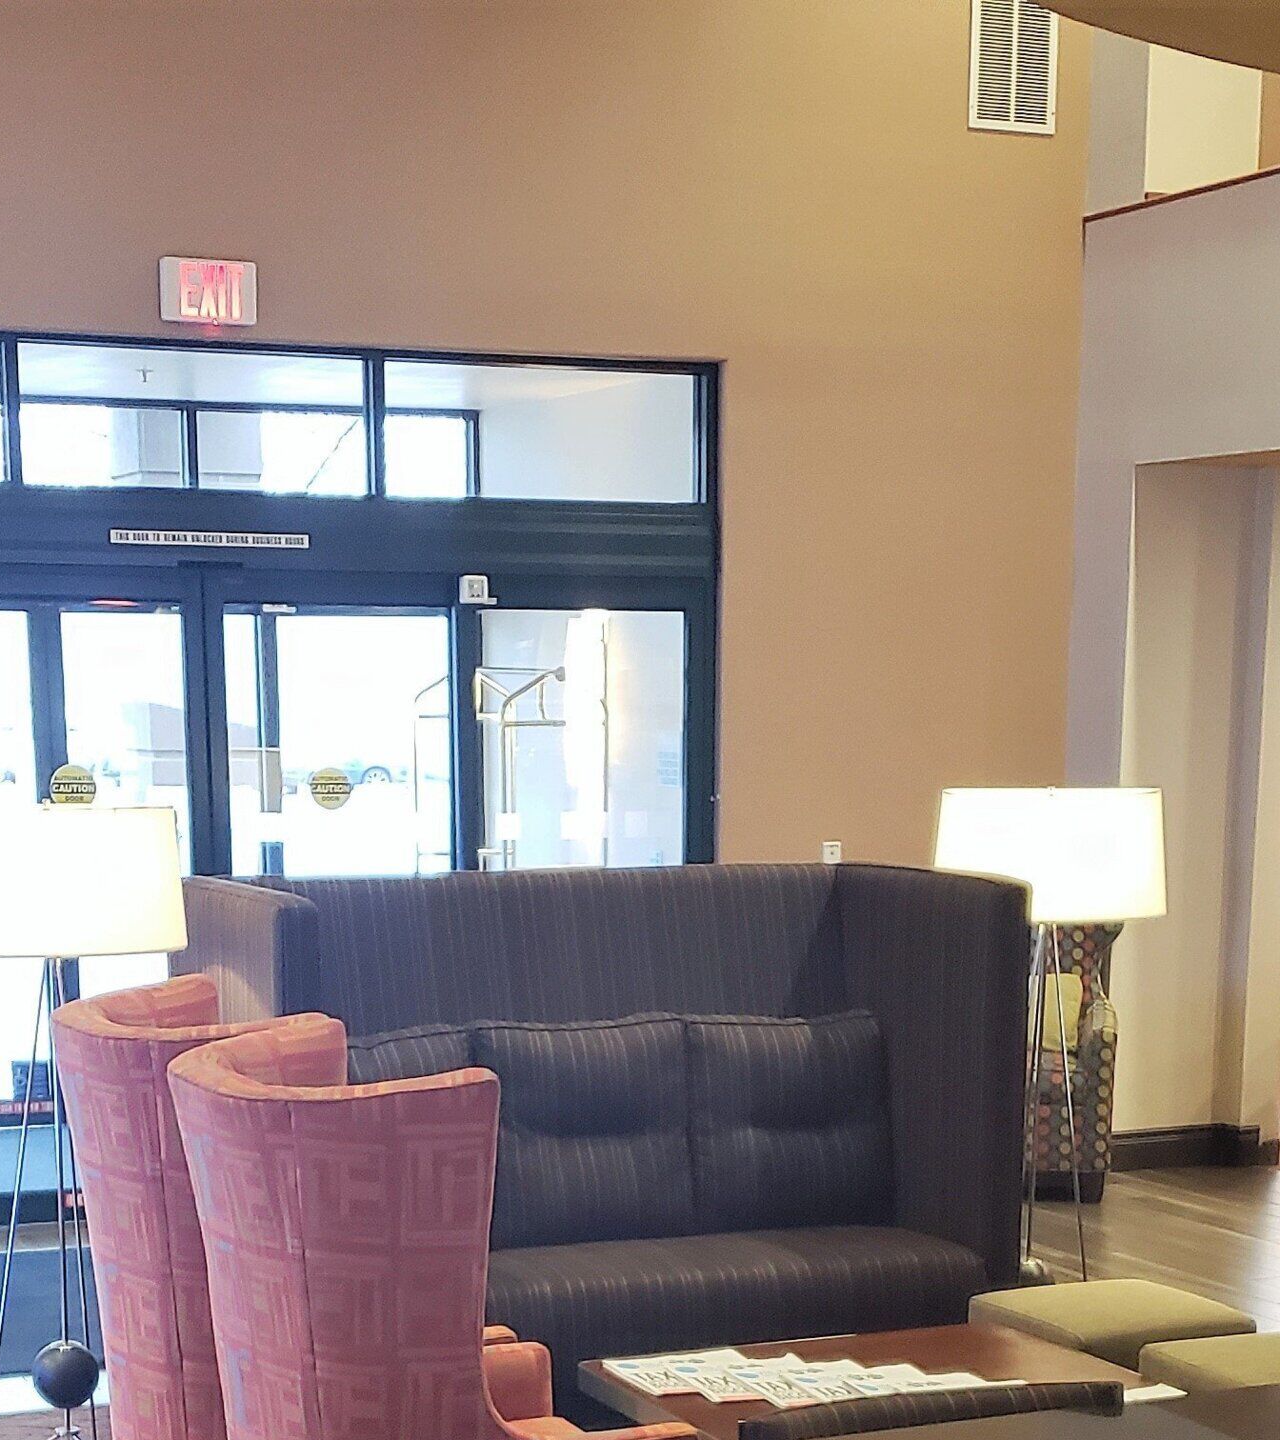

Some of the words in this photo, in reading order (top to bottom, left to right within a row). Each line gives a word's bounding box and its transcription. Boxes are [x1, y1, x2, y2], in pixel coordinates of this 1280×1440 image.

[179, 262, 244, 320] EXIT
[133, 533, 149, 541] DOOR
[153, 533, 160, 541] TO
[192, 534, 223, 543] UNLOCKED
[226, 535, 249, 544] DURING
[252, 536, 281, 544] BUSINESS
[52, 783, 95, 793] CAUTION
[311, 784, 349, 793] CAUTION
[631, 1371, 678, 1382] TAX
[691, 1376, 738, 1386] TAX
